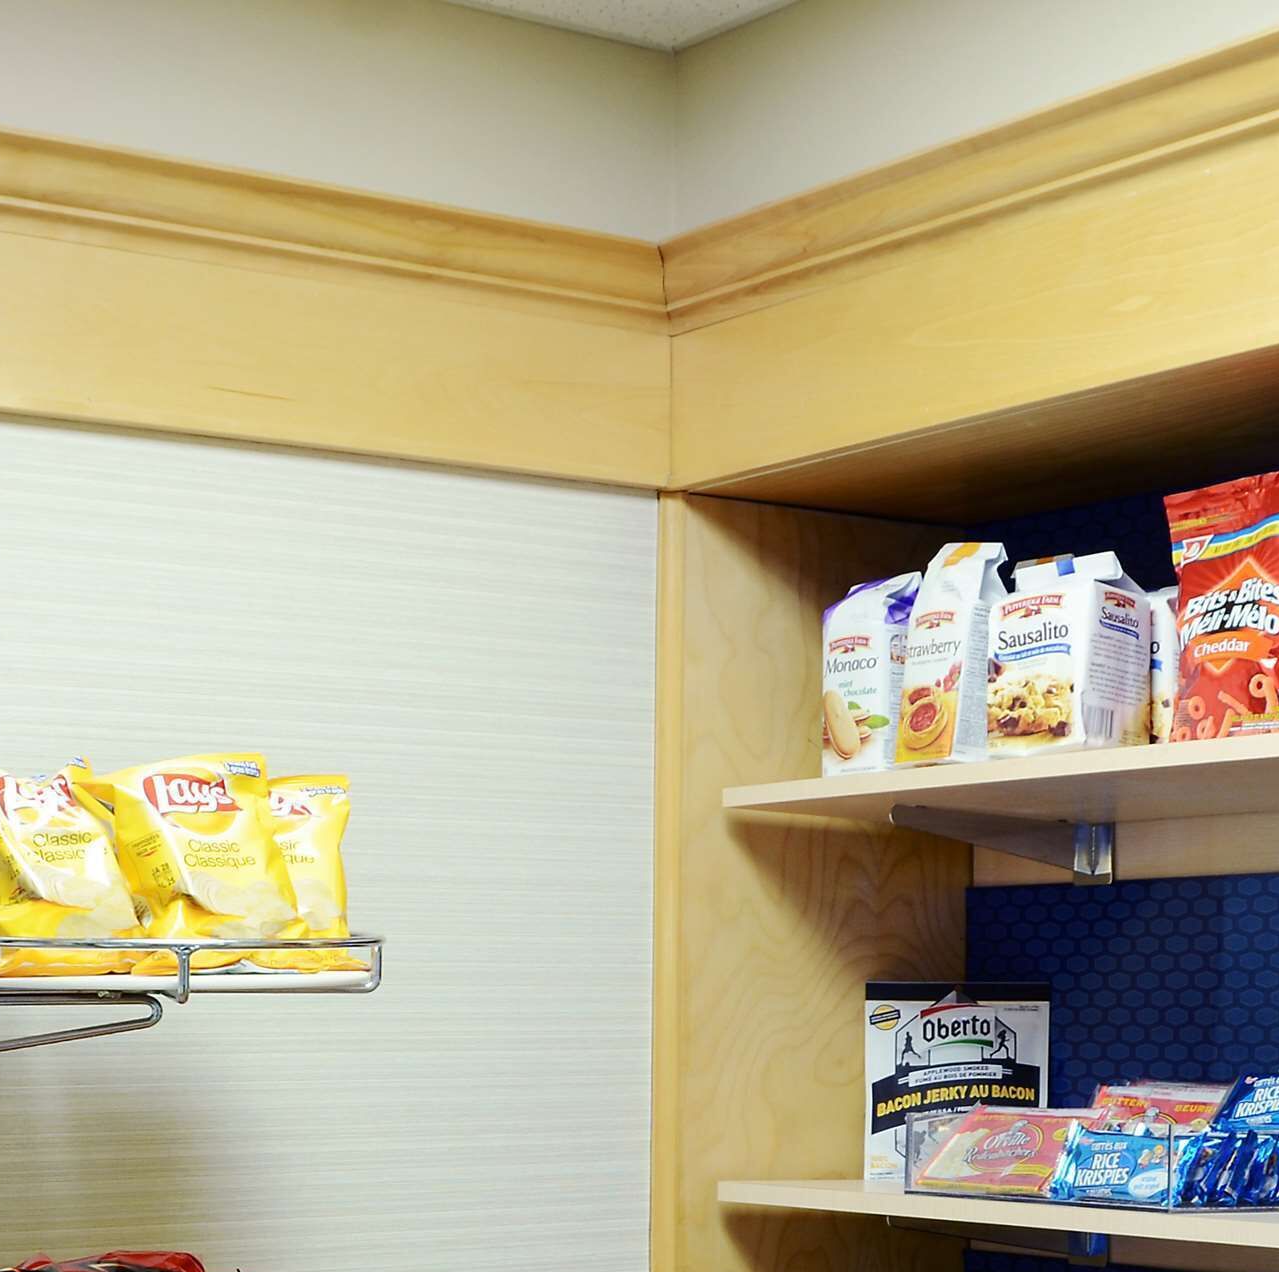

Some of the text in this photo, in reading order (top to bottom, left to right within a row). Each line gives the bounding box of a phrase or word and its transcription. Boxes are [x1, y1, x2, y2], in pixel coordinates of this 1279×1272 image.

[1184, 588, 1228, 620] Bits
[1100, 606, 1139, 629] Sausalito
[997, 621, 1069, 651] Sausalito
[1193, 636, 1251, 658] Cheddar
[824, 655, 878, 679] Monaco
[188, 839, 240, 854] Classic
[183, 853, 256, 869] Classique
[922, 1015, 991, 1043] Oberto
[876, 1084, 1035, 1117] BACON JERKY AU BACON
[1092, 1152, 1120, 1169] RICE
[1074, 1167, 1130, 1187] KRISPIES
